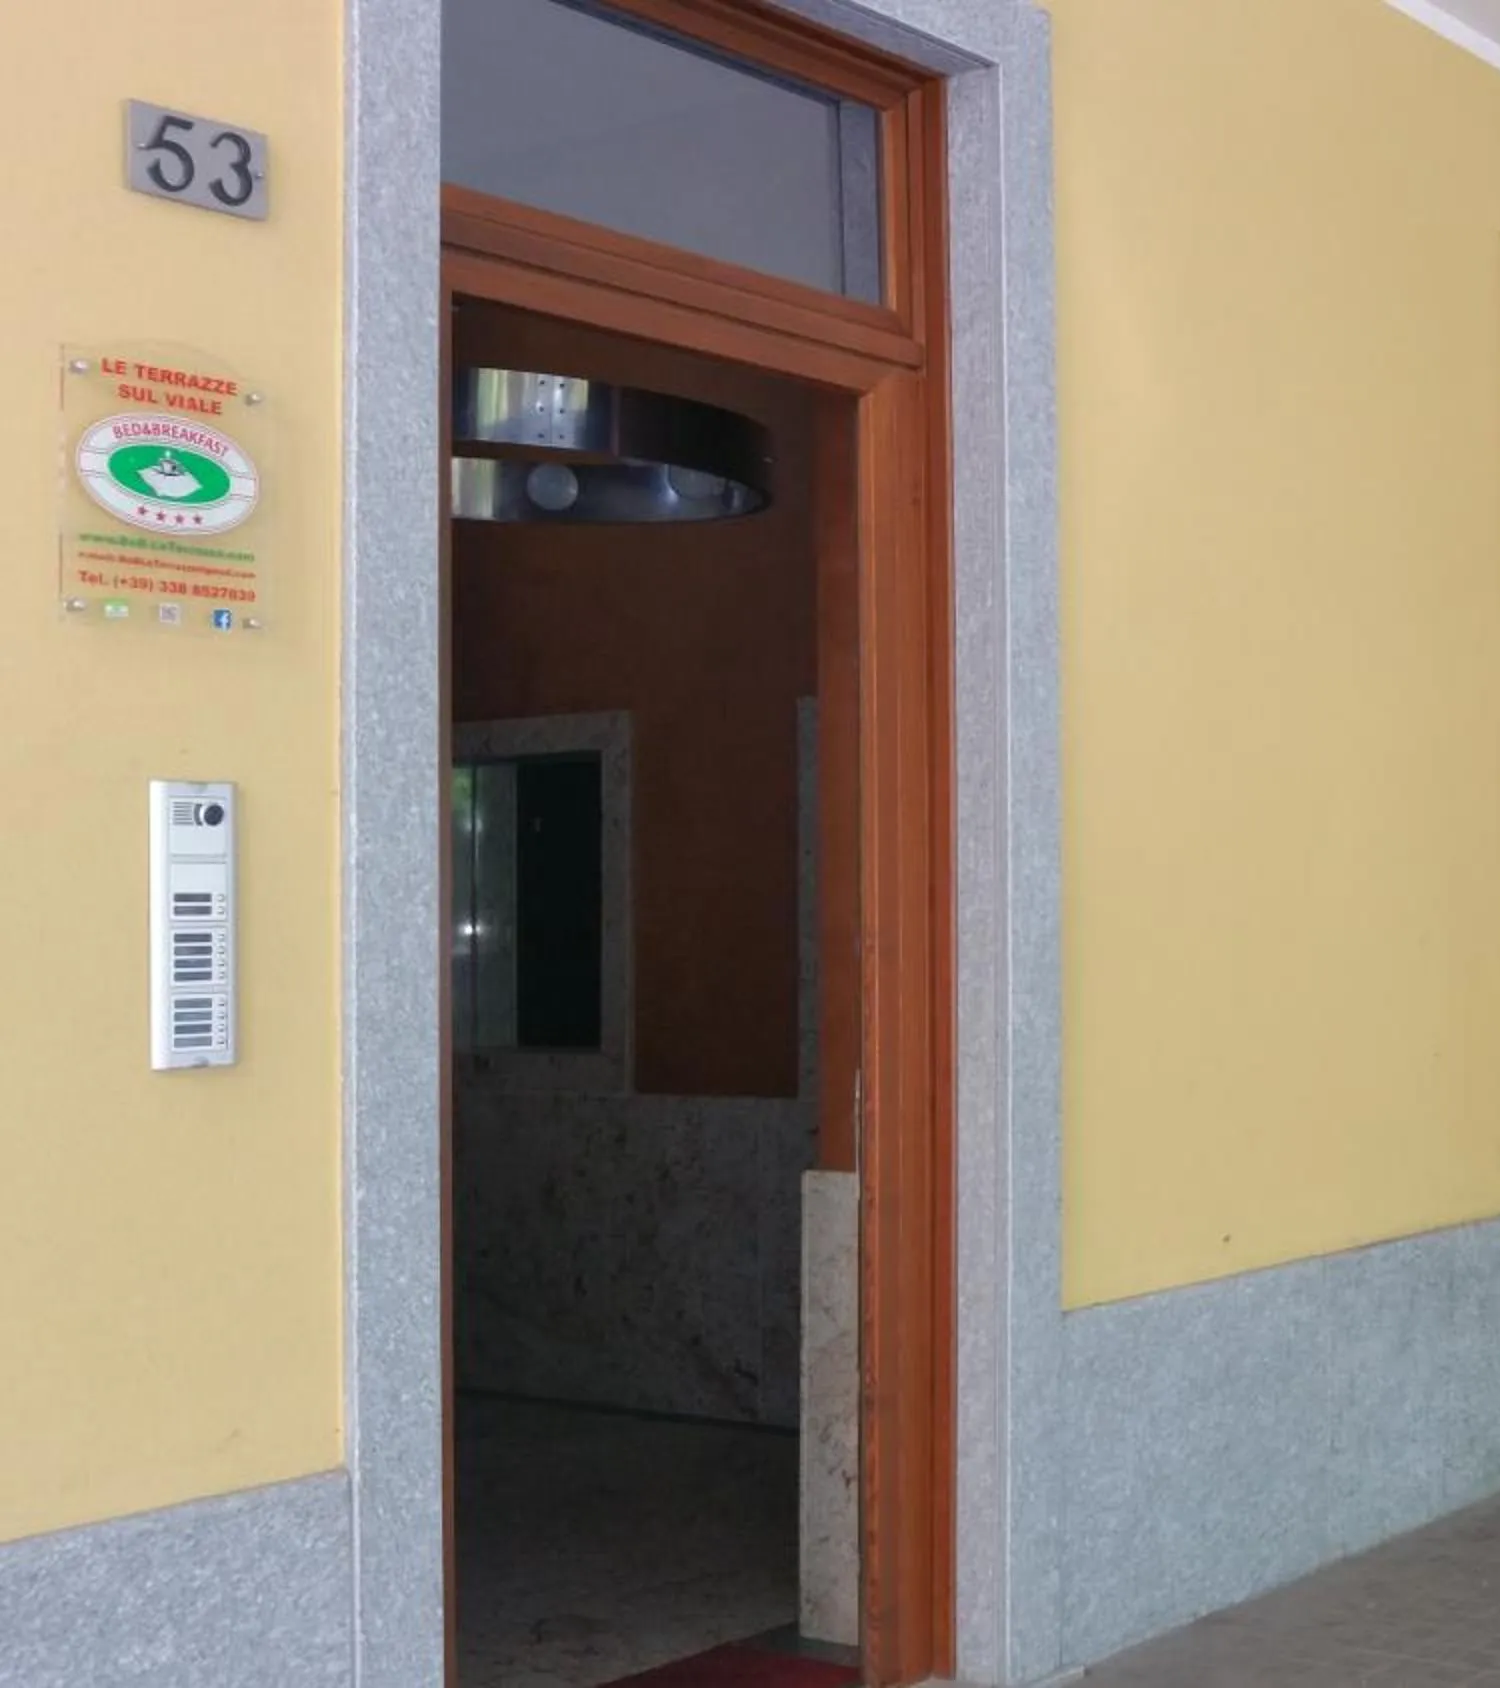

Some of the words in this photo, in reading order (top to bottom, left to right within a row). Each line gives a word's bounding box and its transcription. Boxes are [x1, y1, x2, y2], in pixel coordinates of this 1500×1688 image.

[137, 115, 253, 206] 53
[101, 357, 127, 375] LE
[134, 364, 239, 396] TERRAZZE
[118, 383, 158, 404] SUL
[164, 392, 223, 415] VIALE
[112, 422, 229, 458] BED&BREAKFAST
